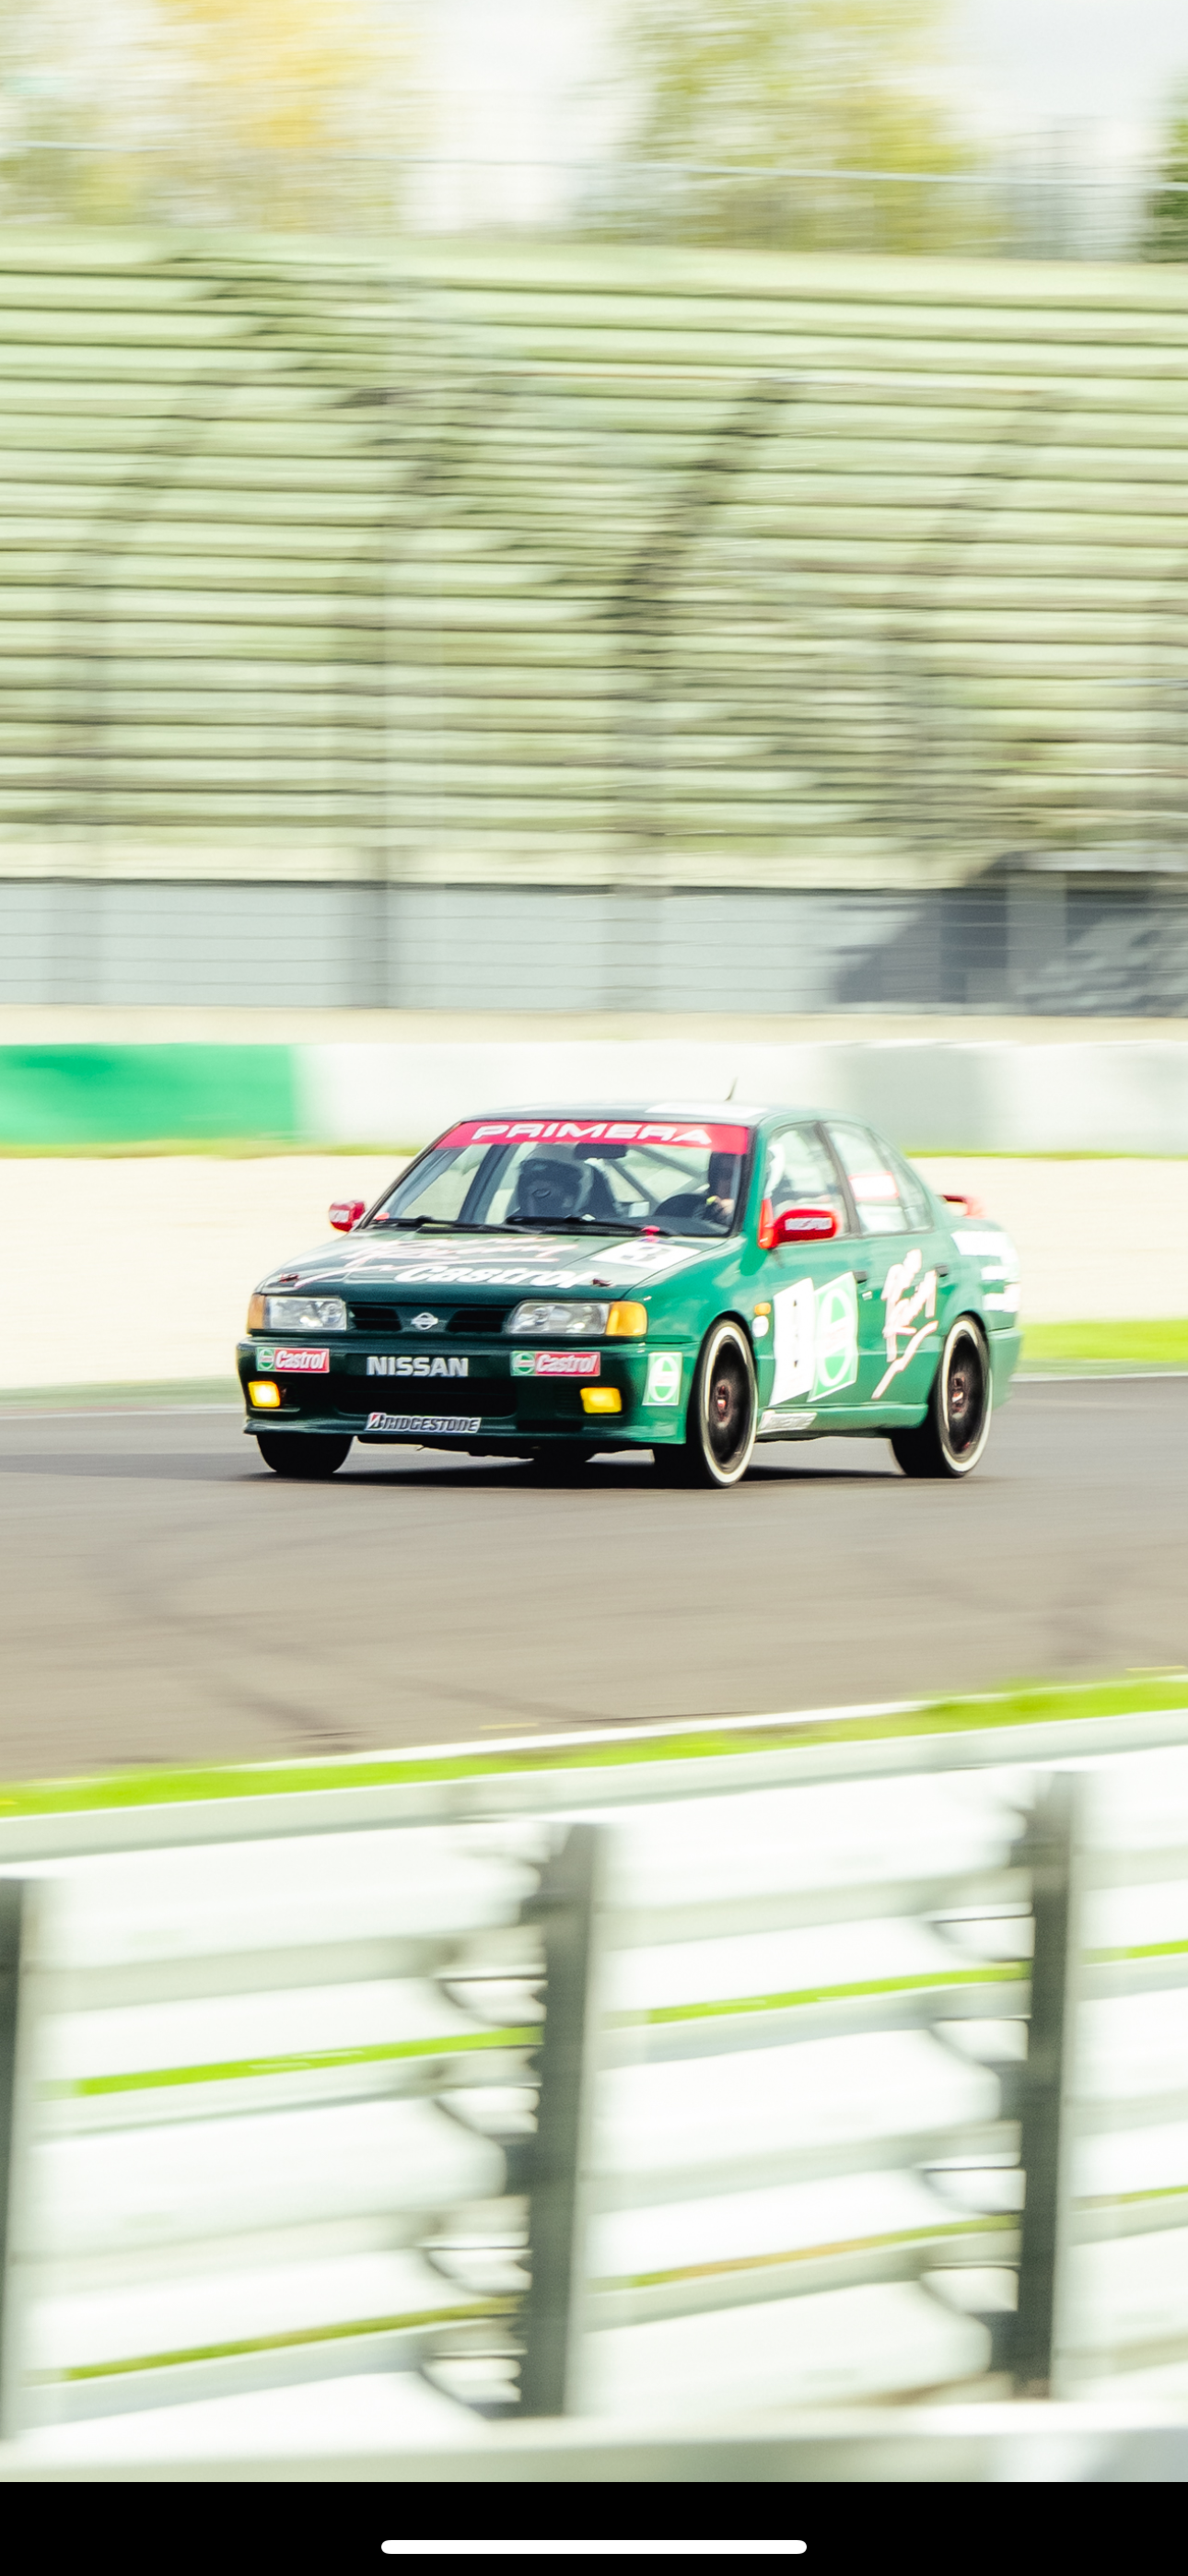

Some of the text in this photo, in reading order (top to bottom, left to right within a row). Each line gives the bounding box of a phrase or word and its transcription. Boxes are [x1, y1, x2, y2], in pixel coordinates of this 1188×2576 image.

[471, 1122, 713, 1144] PRIMERA
[394, 1265, 600, 1289] Castrol
[275, 1350, 327, 1370] Castrol
[366, 1356, 469, 1377] NISSAN
[536, 1353, 599, 1374] Castrol
[367, 1412, 479, 1432] BRIDGESTONE
